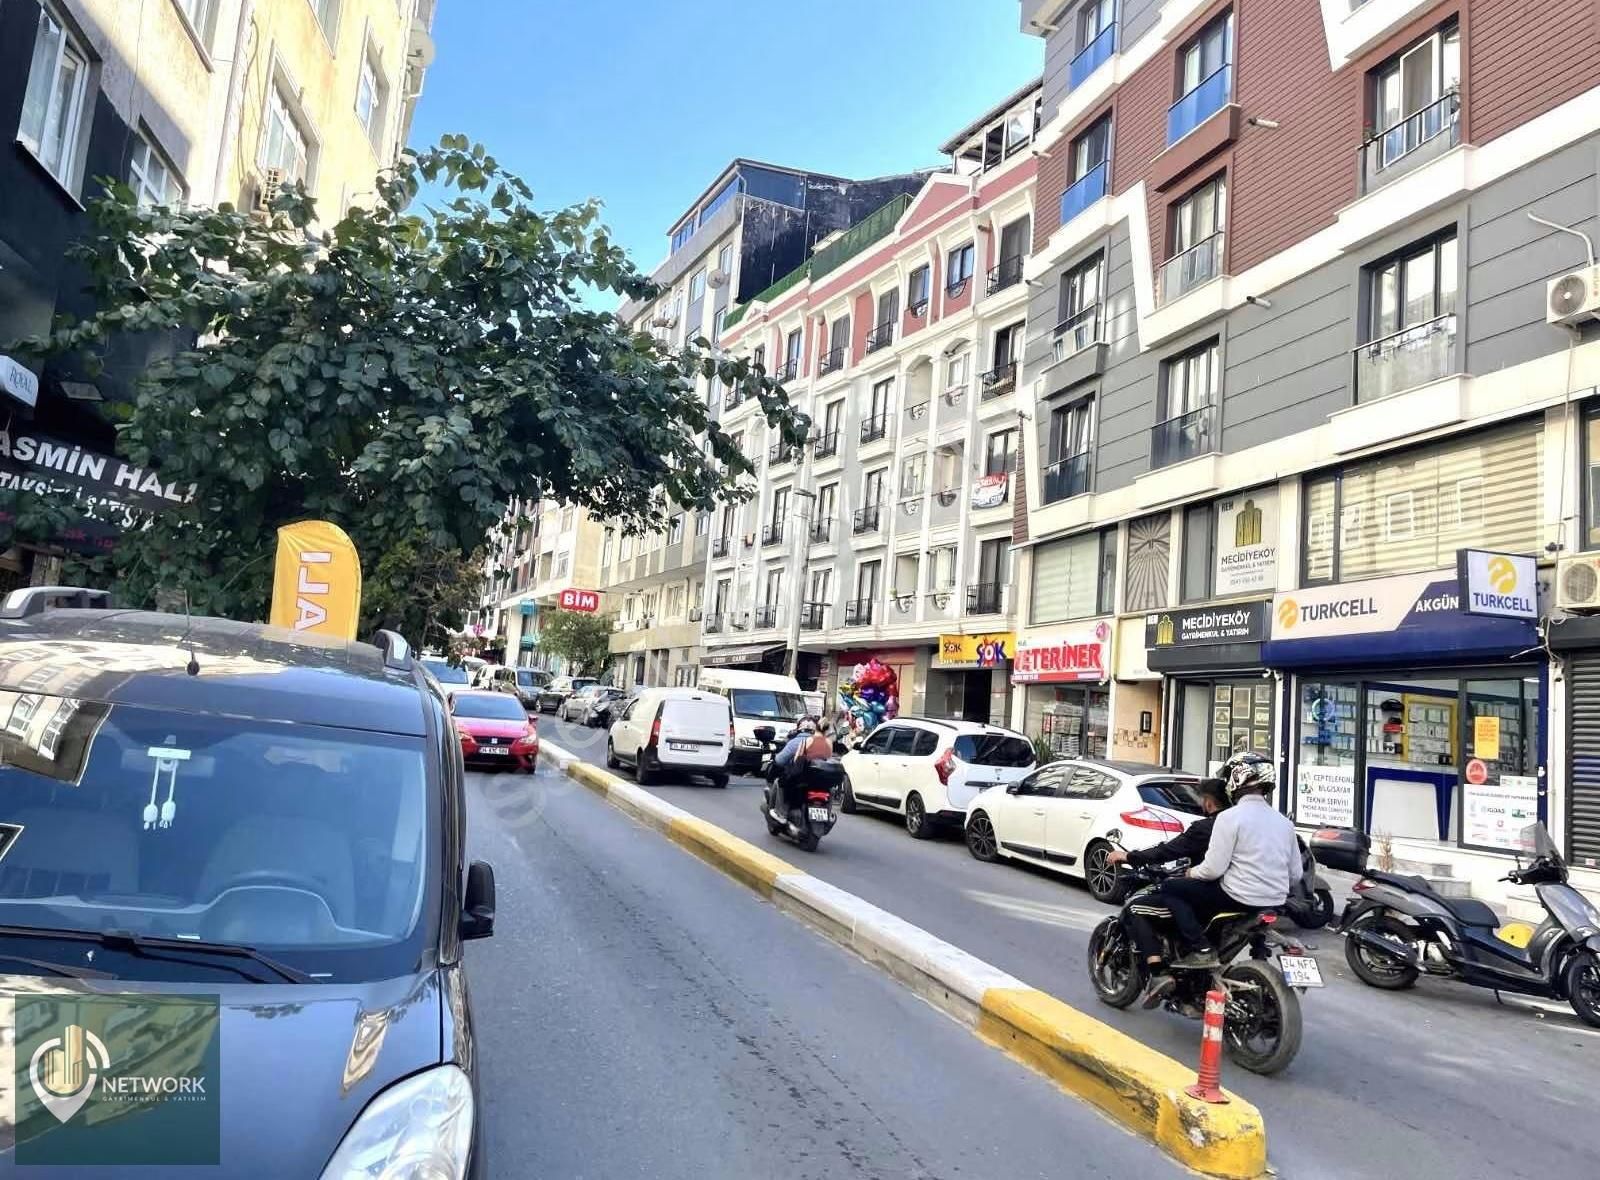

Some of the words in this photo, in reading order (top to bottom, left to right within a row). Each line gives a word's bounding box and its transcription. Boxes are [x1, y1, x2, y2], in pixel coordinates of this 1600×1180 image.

[563, 591, 596, 609] BİM
[1300, 597, 1378, 622] TURKCELL
[1415, 594, 1459, 613] AKGÜN
[1473, 592, 1533, 613] TURKCELL
[1182, 610, 1251, 630] MECİDİYEKÖY
